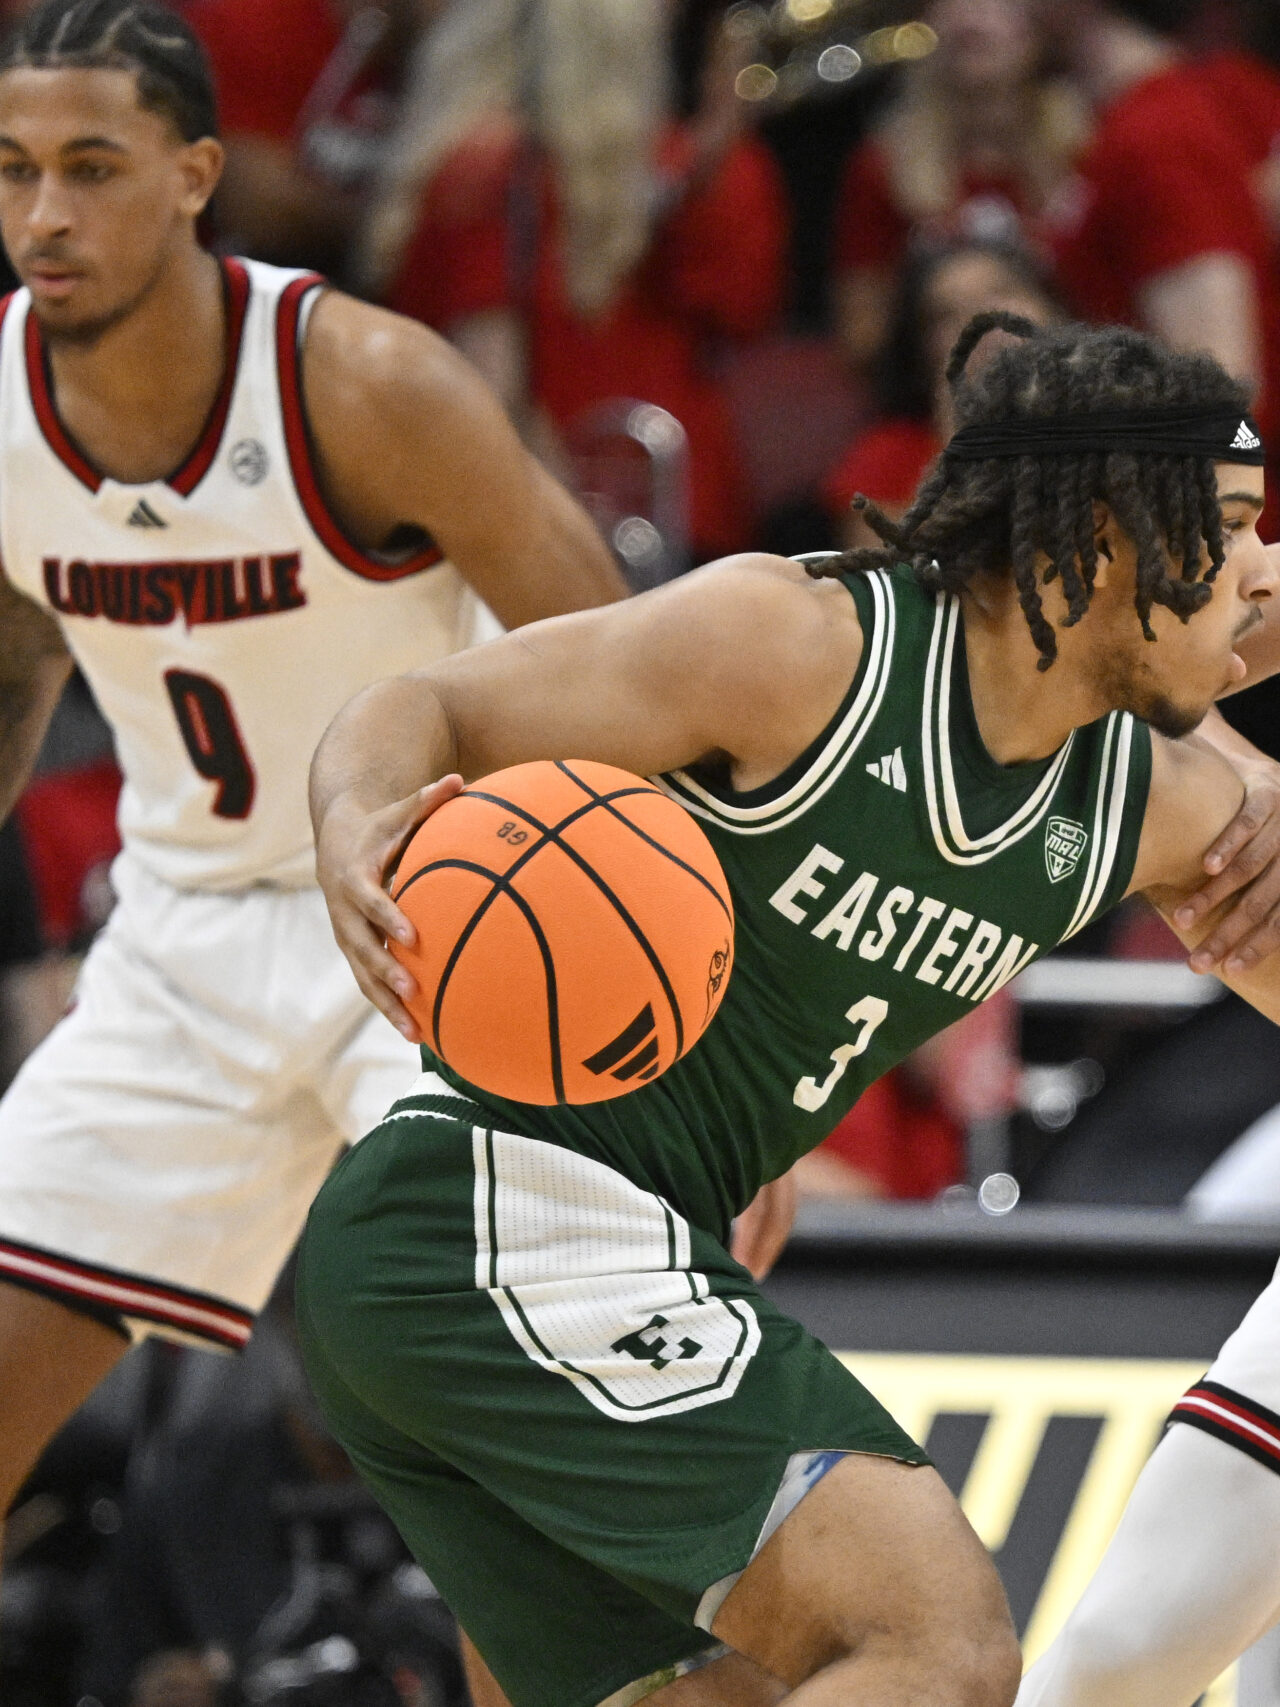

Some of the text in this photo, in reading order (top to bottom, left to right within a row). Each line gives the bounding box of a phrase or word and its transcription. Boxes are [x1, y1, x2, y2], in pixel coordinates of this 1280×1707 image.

[42, 551, 308, 634] LOUISVILLE
[163, 667, 258, 820] 9
[768, 843, 1039, 1002] EASTERN
[793, 995, 889, 1112] 3
